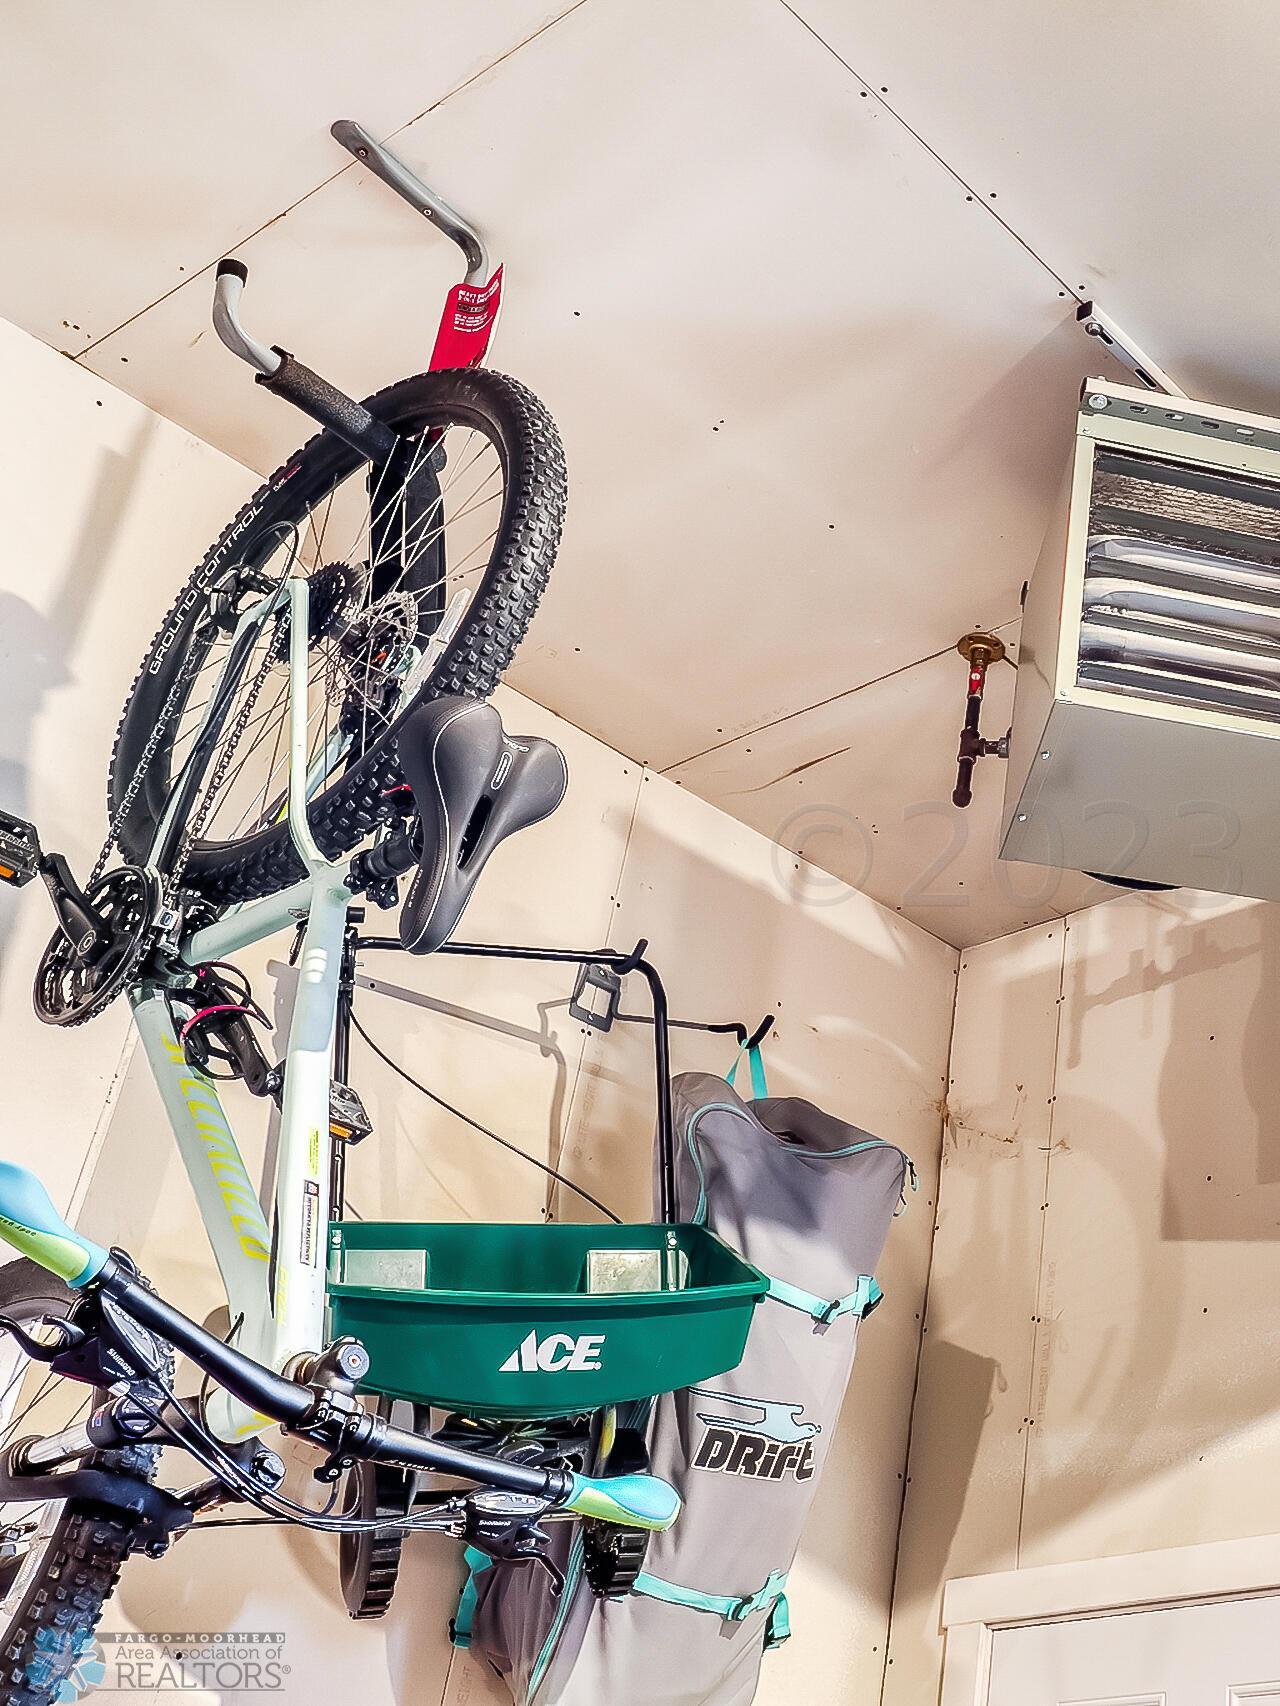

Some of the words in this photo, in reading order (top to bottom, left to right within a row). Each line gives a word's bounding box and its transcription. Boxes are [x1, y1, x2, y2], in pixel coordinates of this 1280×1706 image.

[149, 588, 199, 676] GROUND
[196, 504, 265, 590] CONTROL
[498, 1328, 606, 1372] ACE
